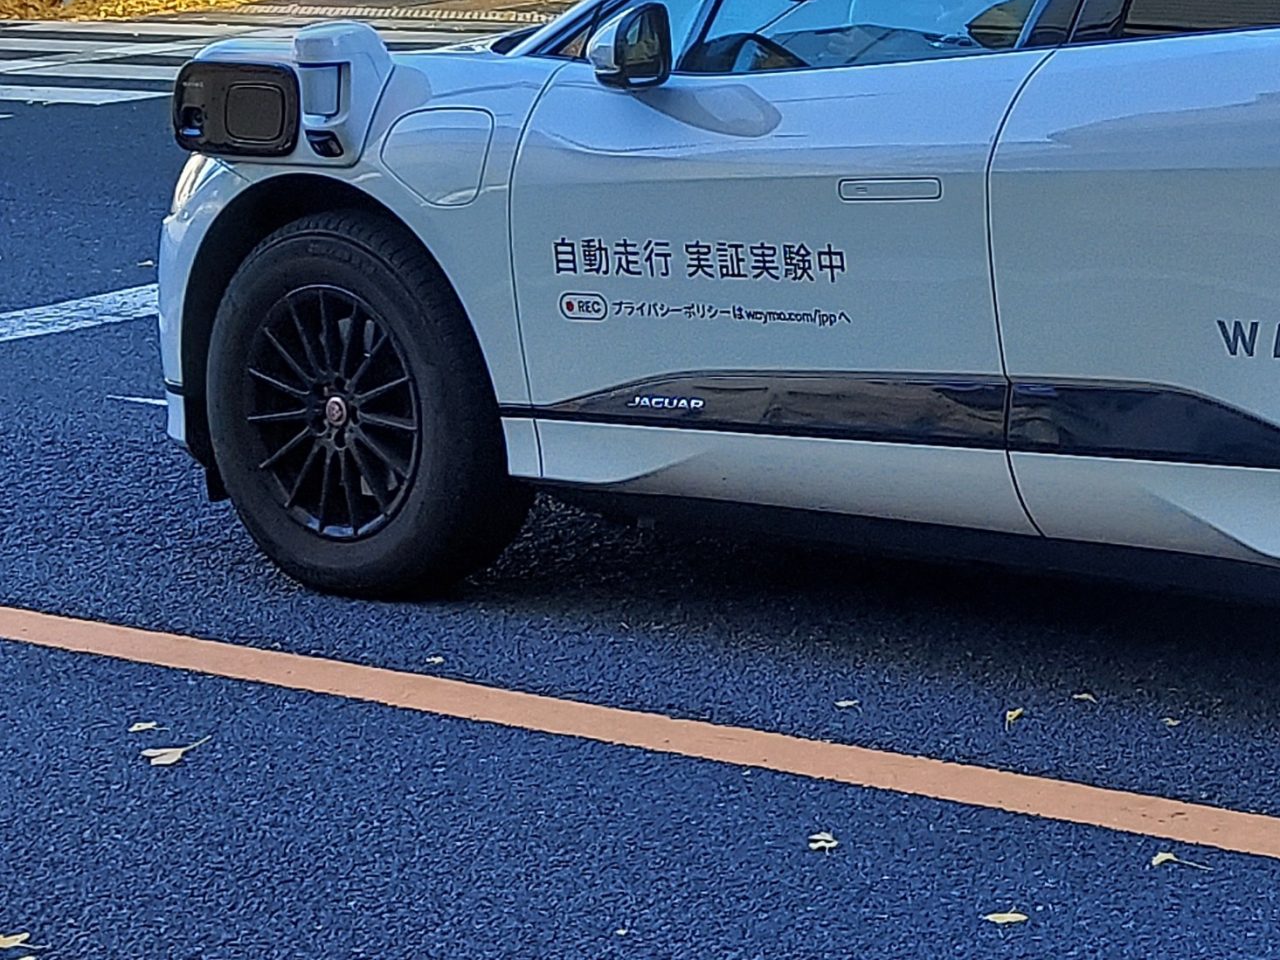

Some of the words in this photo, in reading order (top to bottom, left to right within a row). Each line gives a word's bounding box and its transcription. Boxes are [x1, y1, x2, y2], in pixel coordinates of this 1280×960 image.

[553, 237, 672, 278] 自動走行
[684, 240, 847, 283] 実証実験中
[577, 300, 602, 314] REC
[627, 396, 704, 410] JAGUAR
